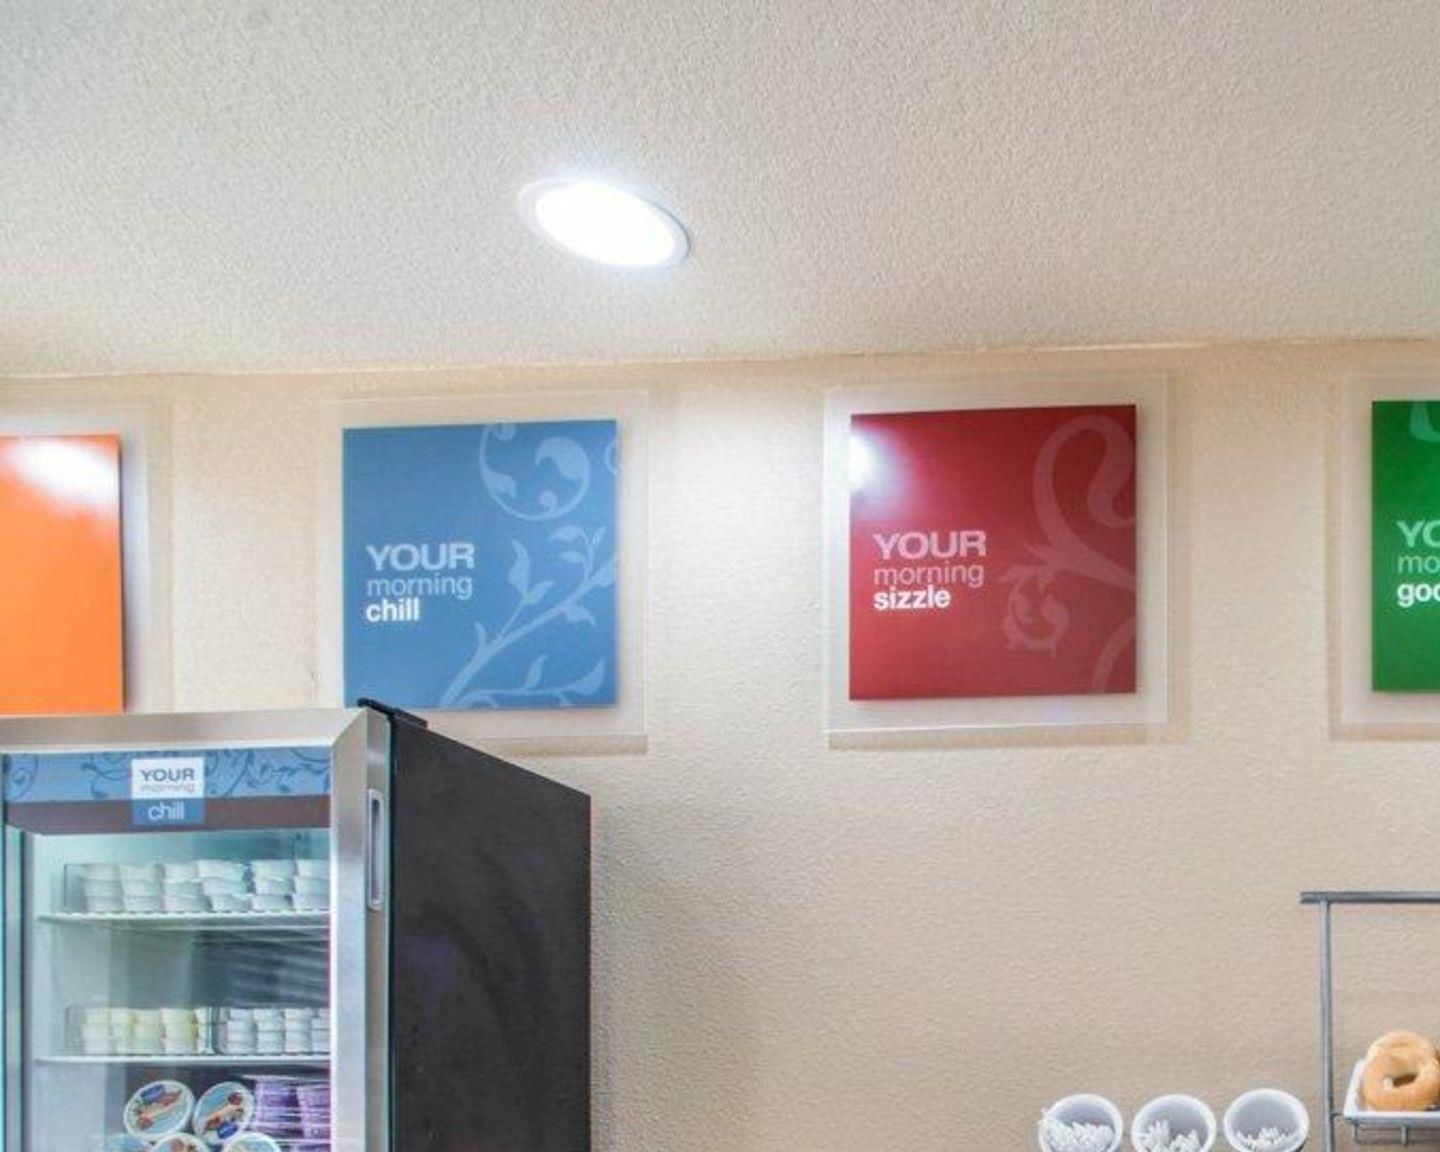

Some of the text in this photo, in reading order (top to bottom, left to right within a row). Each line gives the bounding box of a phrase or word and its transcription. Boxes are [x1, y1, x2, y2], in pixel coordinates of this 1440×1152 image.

[366, 542, 475, 571] YOUR
[873, 529, 987, 560] YOUR
[366, 572, 473, 600] morning
[873, 560, 984, 588] morning
[366, 596, 420, 622] chill
[873, 584, 951, 610] sizzle
[140, 767, 195, 782] YOUR
[147, 801, 185, 821] chill
